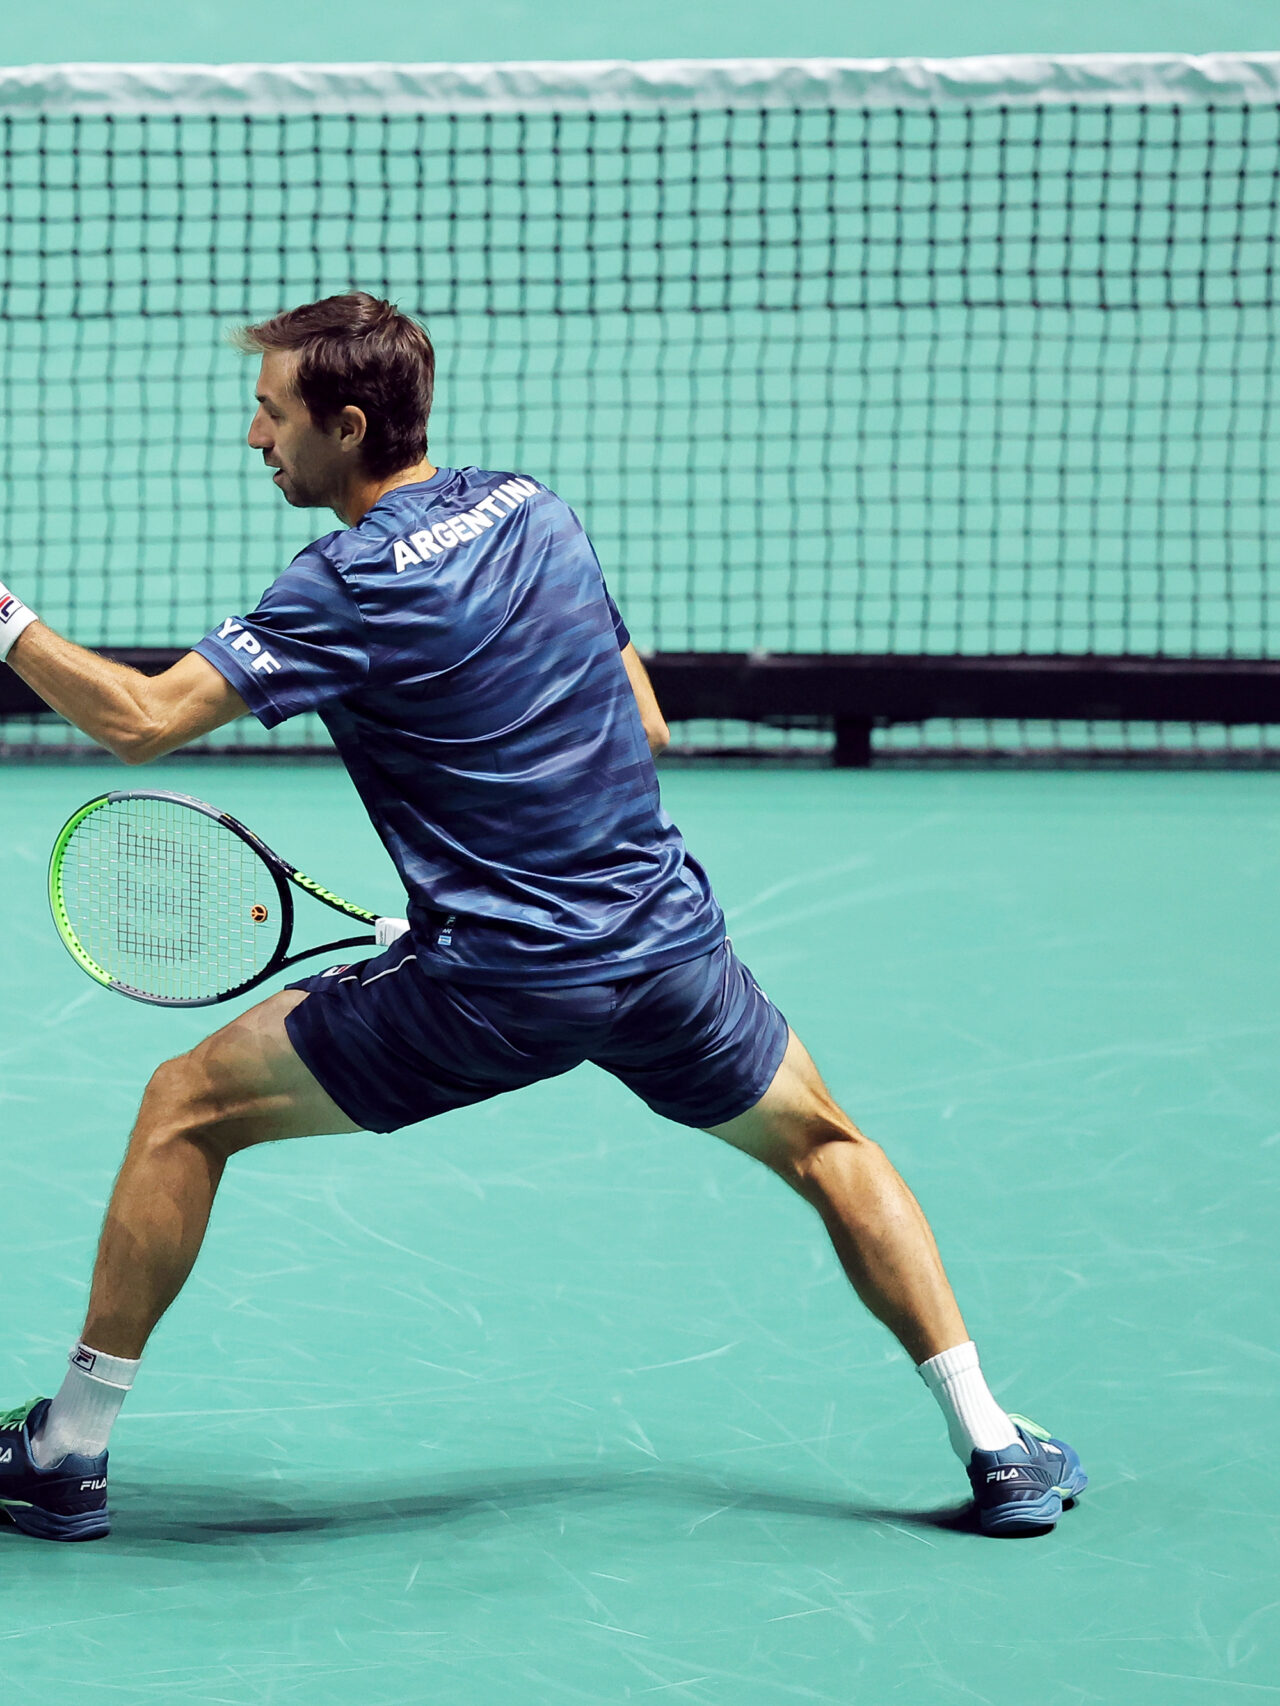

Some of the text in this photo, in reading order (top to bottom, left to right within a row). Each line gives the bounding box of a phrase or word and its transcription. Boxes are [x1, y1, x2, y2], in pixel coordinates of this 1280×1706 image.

[216, 617, 282, 674] YPF
[986, 1468, 1019, 1483] FILA
[80, 1477, 107, 1491] FILA
